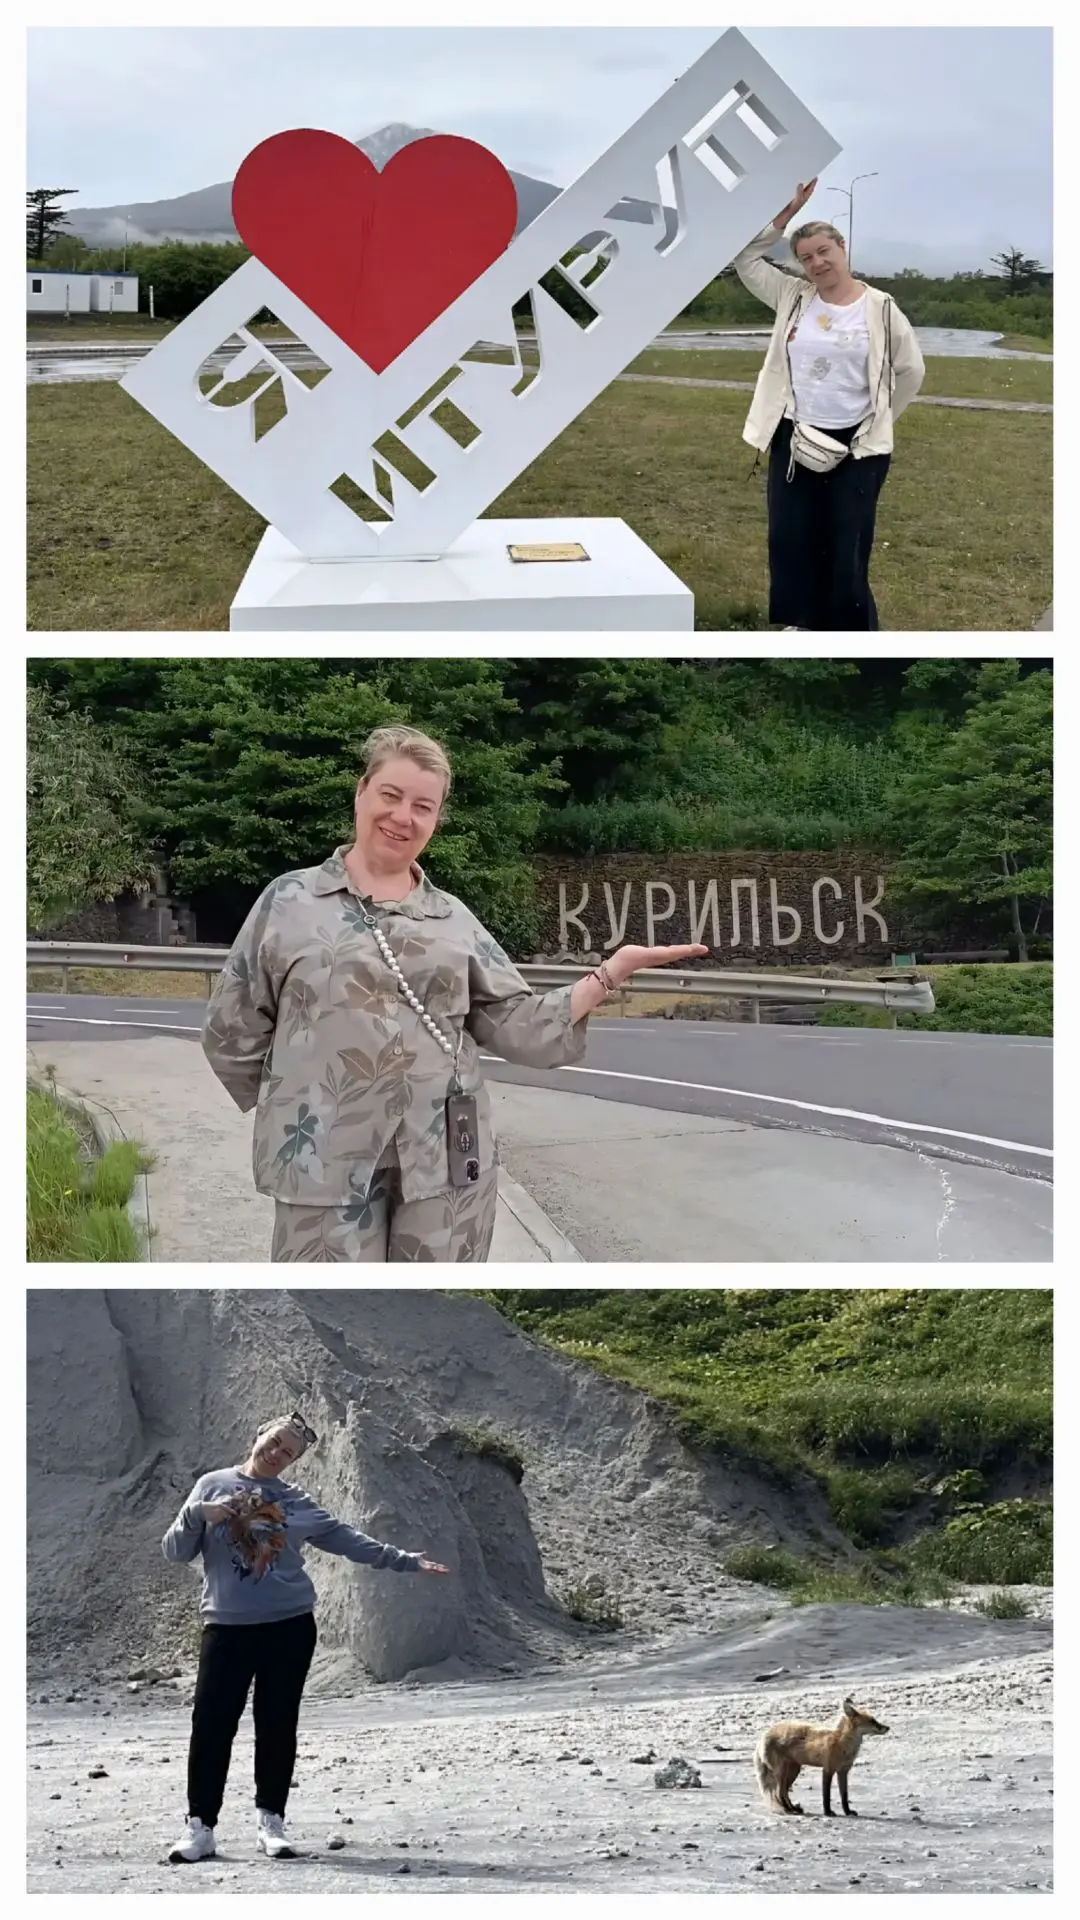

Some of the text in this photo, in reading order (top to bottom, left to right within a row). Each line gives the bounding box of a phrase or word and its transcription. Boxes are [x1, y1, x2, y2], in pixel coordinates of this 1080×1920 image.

[194, 305, 333, 443] Я
[327, 79, 789, 534] ИТУРУП
[558, 875, 889, 951] КУРИЛЬСК
